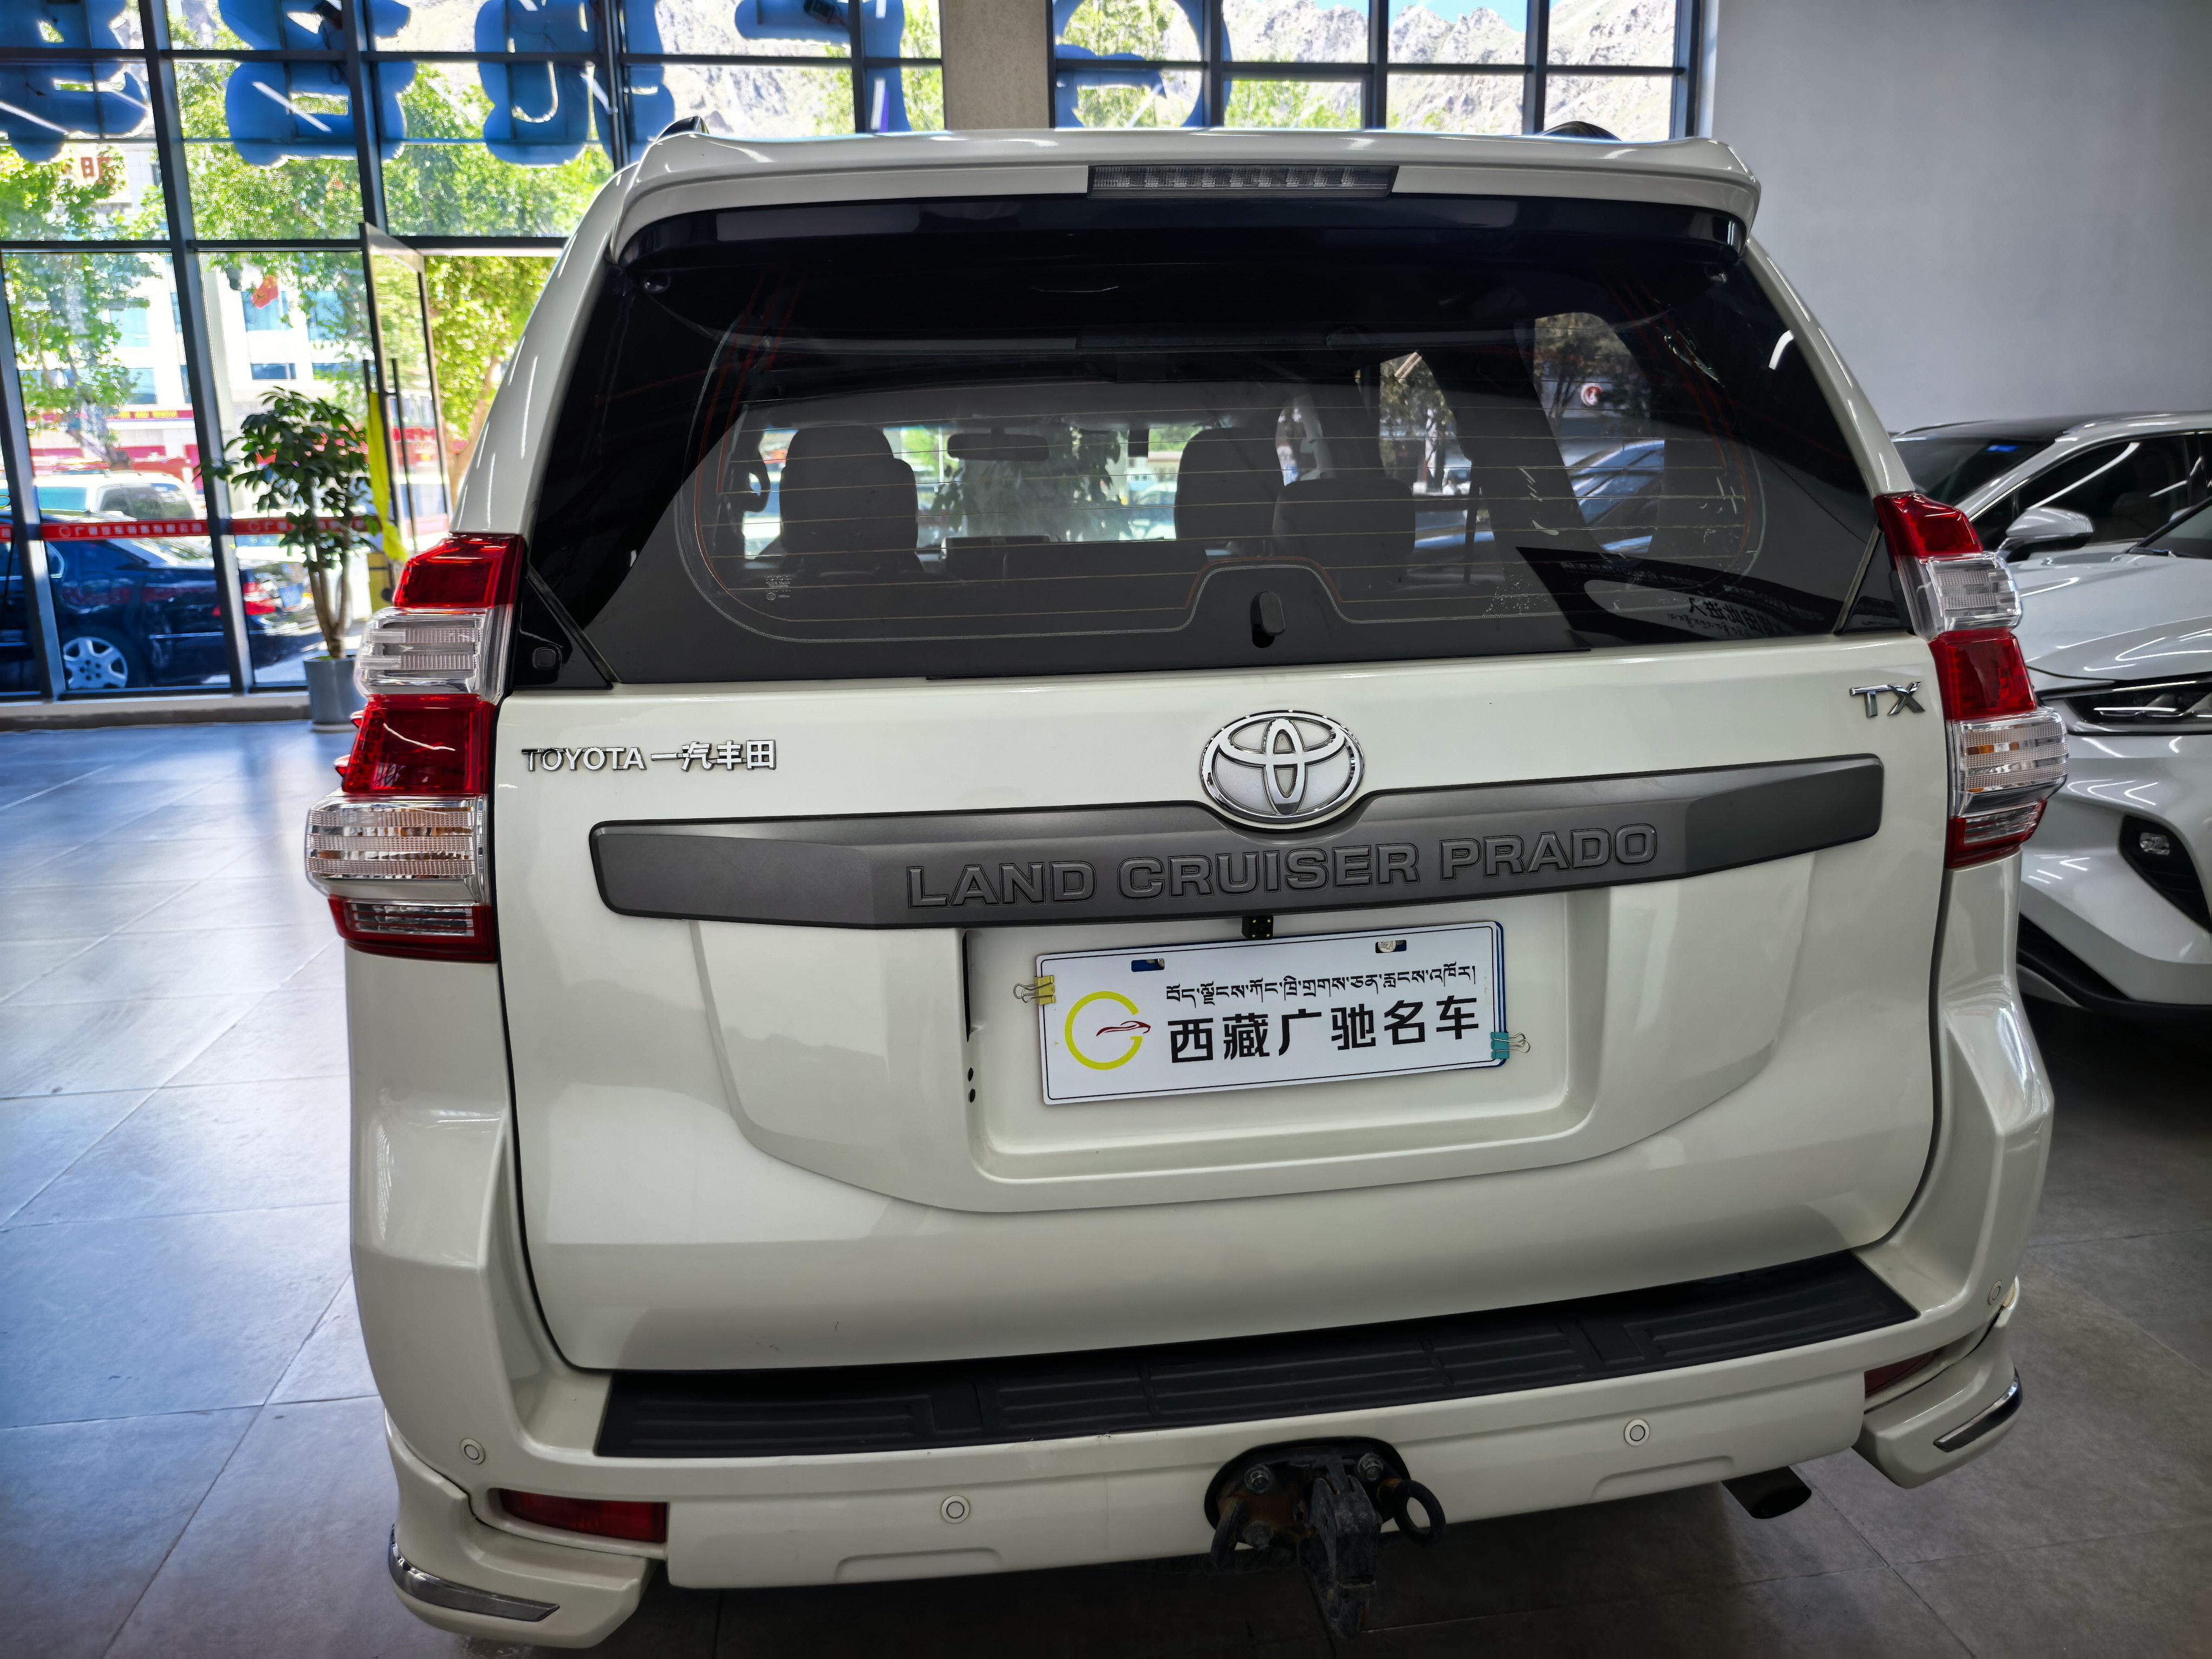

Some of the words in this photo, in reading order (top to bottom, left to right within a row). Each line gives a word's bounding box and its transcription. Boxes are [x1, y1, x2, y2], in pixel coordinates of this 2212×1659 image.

[1849, 681, 1925, 718] TX
[521, 747, 647, 771] TOYOTA
[651, 739, 776, 771] 一汽丰田
[907, 861, 1097, 909] LAND
[1116, 842, 1420, 901] CRUISER
[1439, 823, 1657, 881] PRADO
[1167, 995, 1479, 1063] 西藏广驰名车
